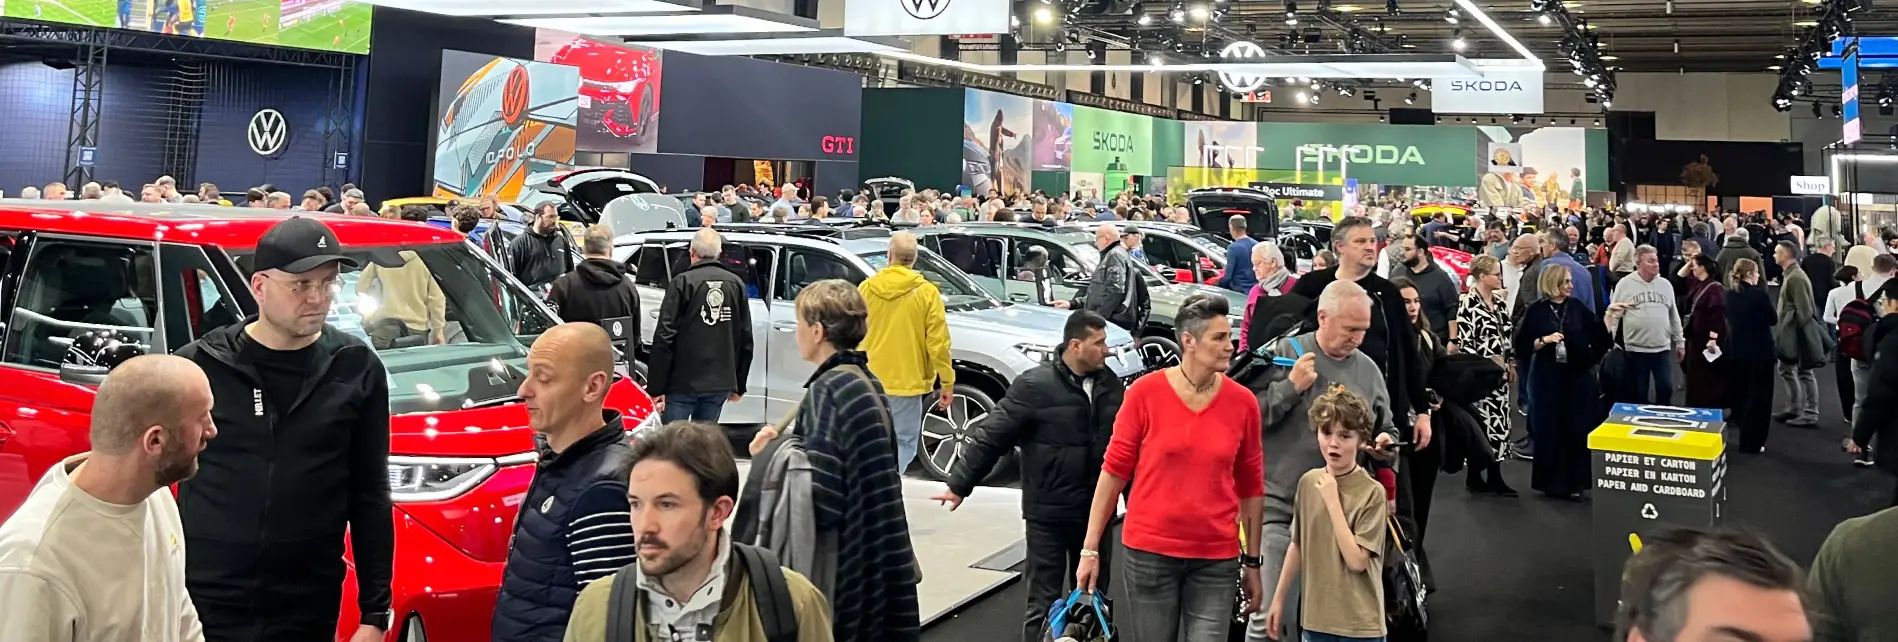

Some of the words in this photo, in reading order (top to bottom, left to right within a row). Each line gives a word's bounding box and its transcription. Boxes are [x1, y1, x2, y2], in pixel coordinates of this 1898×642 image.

[498, 142, 535, 160] POLO
[822, 135, 854, 154] GTI
[1282, 186, 1325, 198] Ultimate
[1796, 180, 1826, 192] Shop
[1605, 453, 1639, 465] PAPIER
[1644, 457, 1656, 466] ET
[1661, 459, 1696, 470] CARTON
[1605, 467, 1639, 478] PAPIER
[1644, 470, 1656, 480] EN
[1661, 472, 1696, 483] KARTON
[1598, 479, 1626, 490] PAPER
[1631, 482, 1648, 492] AND
[1653, 485, 1706, 499] CARDBOARD
